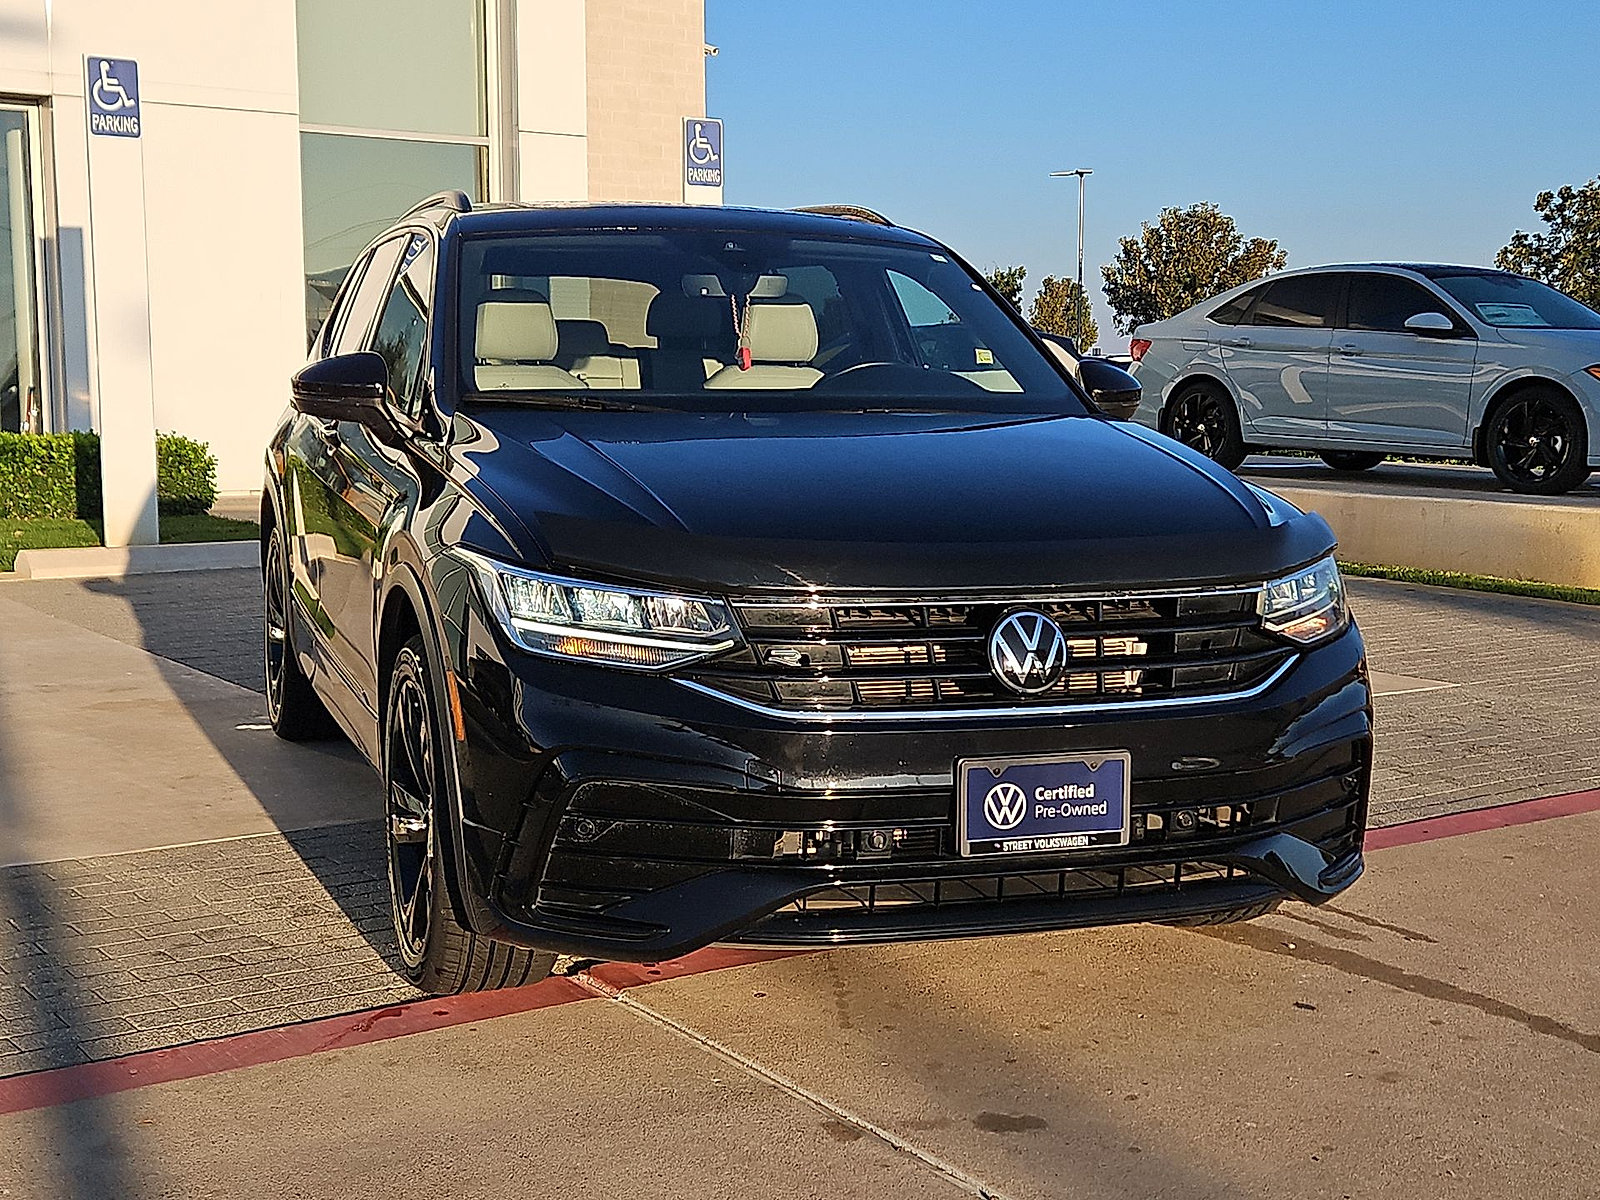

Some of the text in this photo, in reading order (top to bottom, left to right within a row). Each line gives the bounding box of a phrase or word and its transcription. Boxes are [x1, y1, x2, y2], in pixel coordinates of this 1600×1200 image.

[92, 113, 139, 134] PARKING
[688, 167, 721, 183] PARKING
[1035, 784, 1095, 801] Certified
[984, 783, 1027, 830] VW
[1035, 801, 1108, 819] Pre-Owned
[1002, 835, 1089, 852] STREET VOLKSWAGEN
